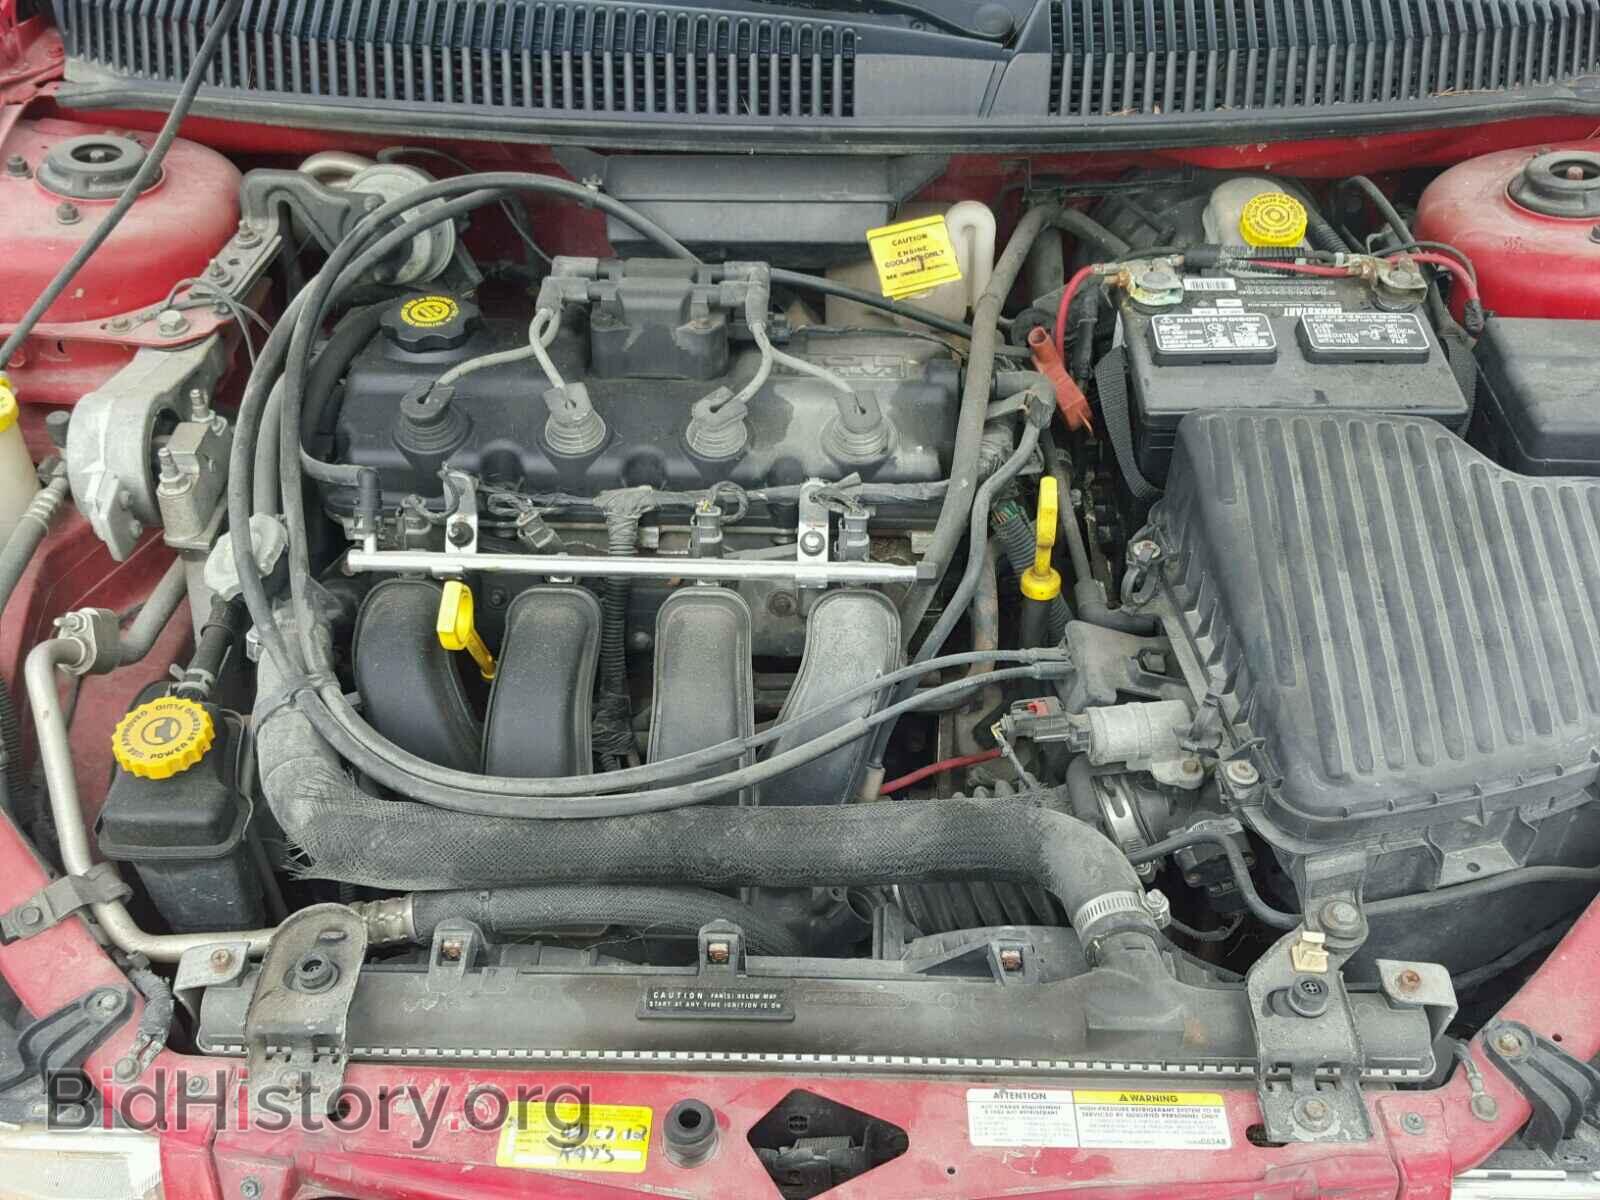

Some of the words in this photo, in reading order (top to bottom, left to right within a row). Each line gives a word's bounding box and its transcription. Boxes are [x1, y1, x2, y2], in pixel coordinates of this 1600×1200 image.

[891, 233, 927, 246] CAUTION
[897, 246, 928, 257] ENGINE
[150, 742, 188, 760] POWER
[993, 1092, 1047, 1100] ATTENTION
[1130, 1094, 1179, 1103] WARNING
